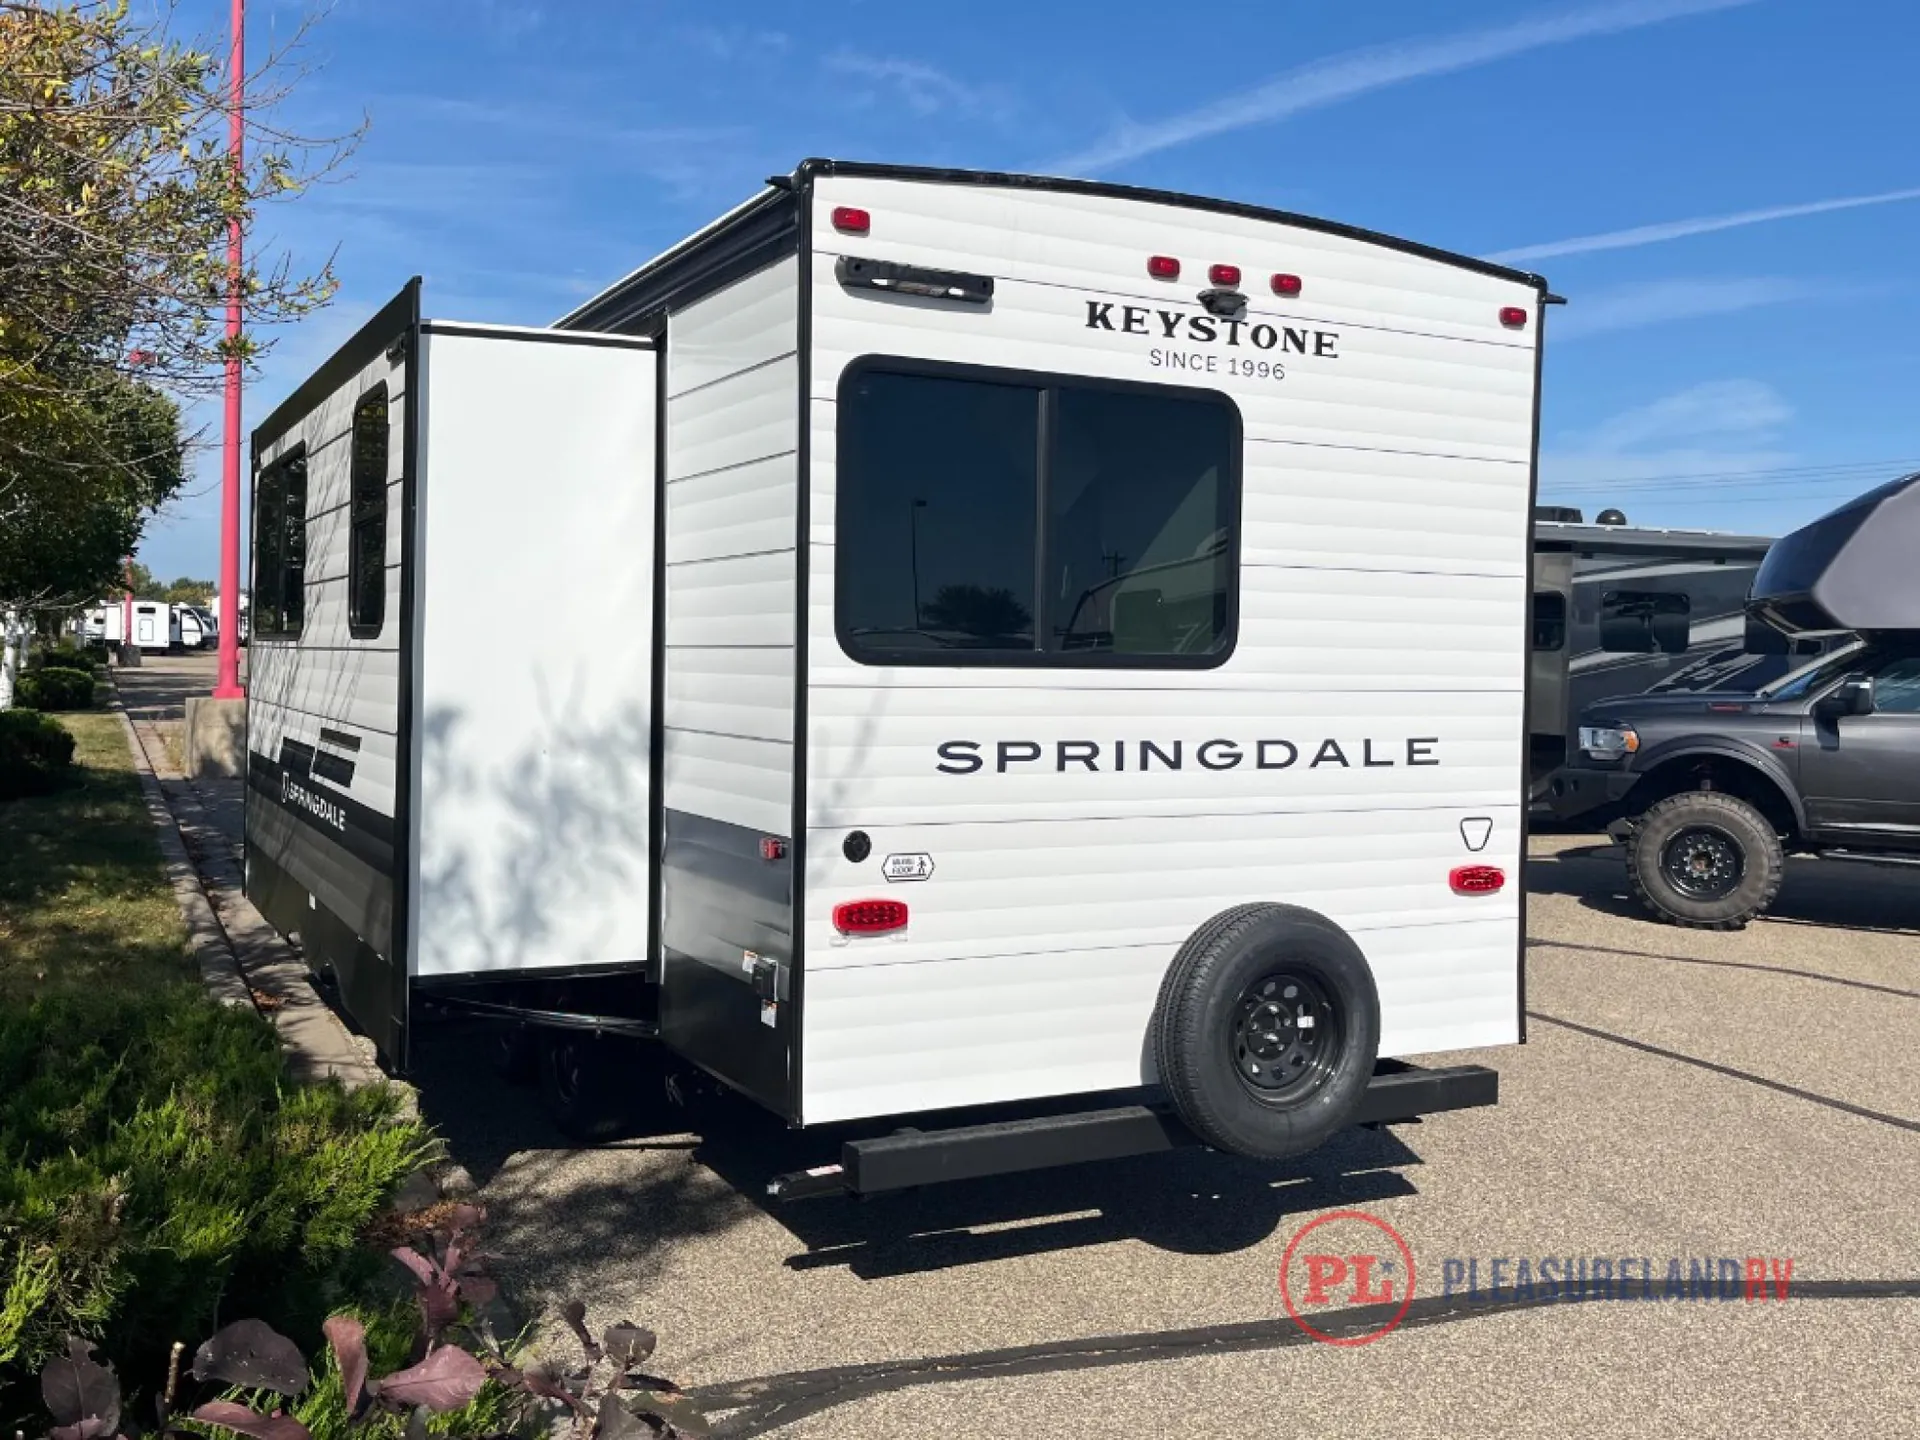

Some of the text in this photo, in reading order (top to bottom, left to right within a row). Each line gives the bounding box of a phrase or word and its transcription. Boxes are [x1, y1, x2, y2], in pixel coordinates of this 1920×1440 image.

[1085, 300, 1339, 358] KEYSTONE
[1150, 348, 1285, 381] SINCE 1996
[936, 737, 1439, 775] SPRINGDALE
